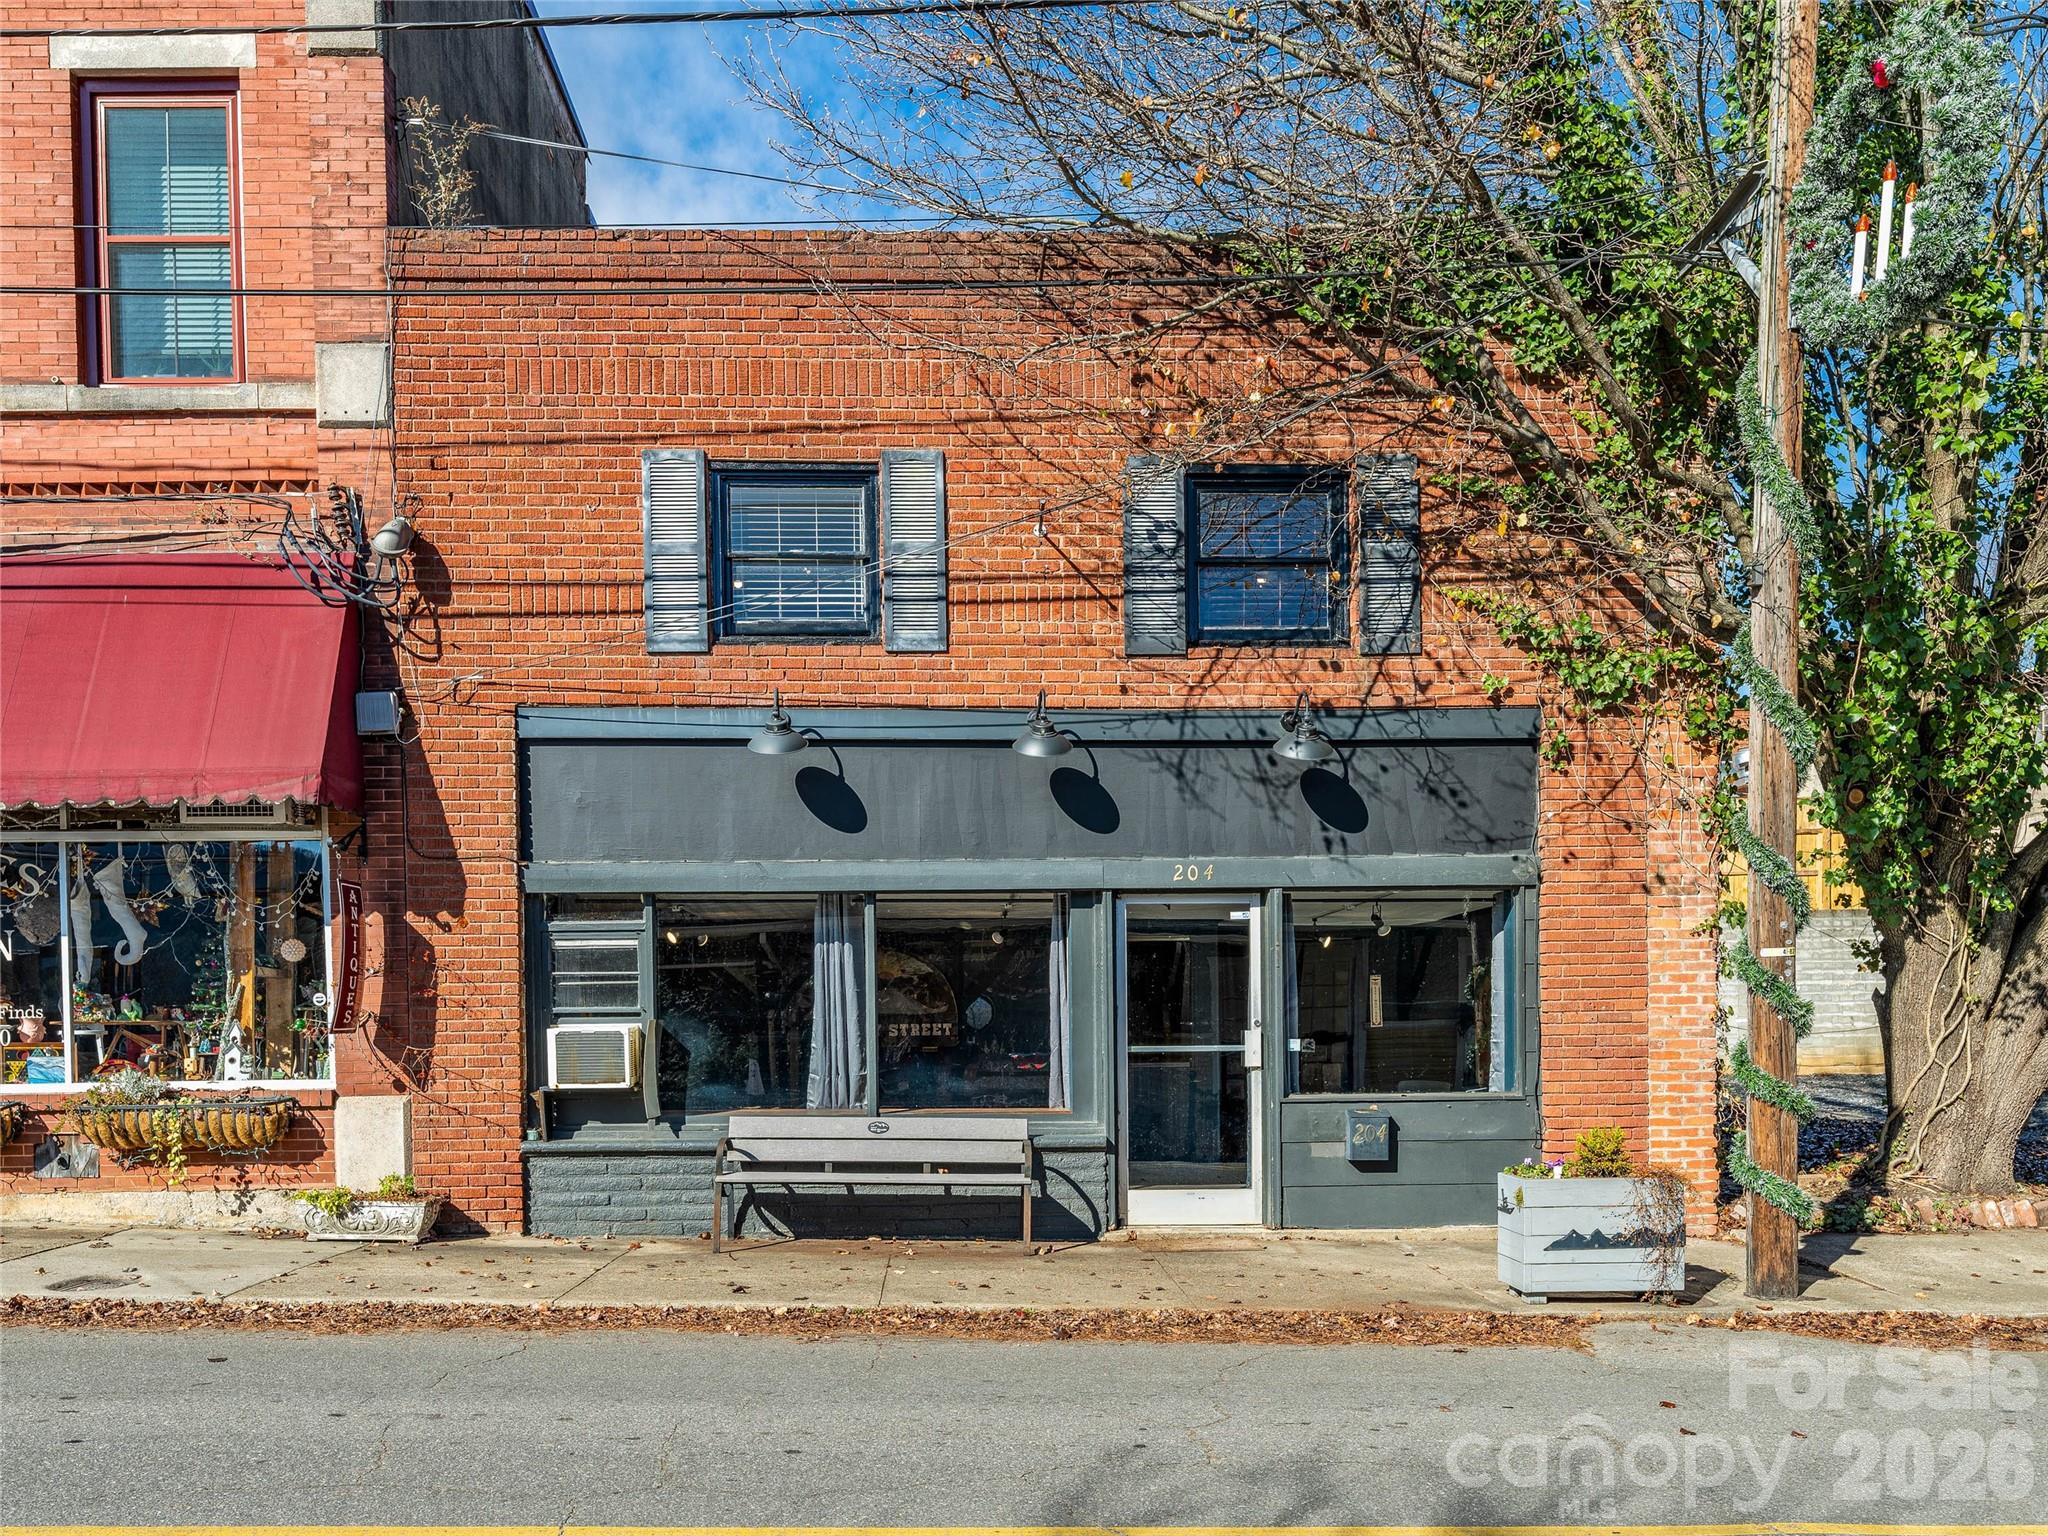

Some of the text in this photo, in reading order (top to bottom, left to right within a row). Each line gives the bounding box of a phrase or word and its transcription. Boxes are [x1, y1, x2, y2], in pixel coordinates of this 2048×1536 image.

[1173, 864, 1213, 881] 204
[343, 889, 360, 1024] ANTIQUES
[0, 1004, 44, 1019] Finds
[888, 1023, 952, 1037] STREET
[1353, 1123, 1387, 1144] 204
